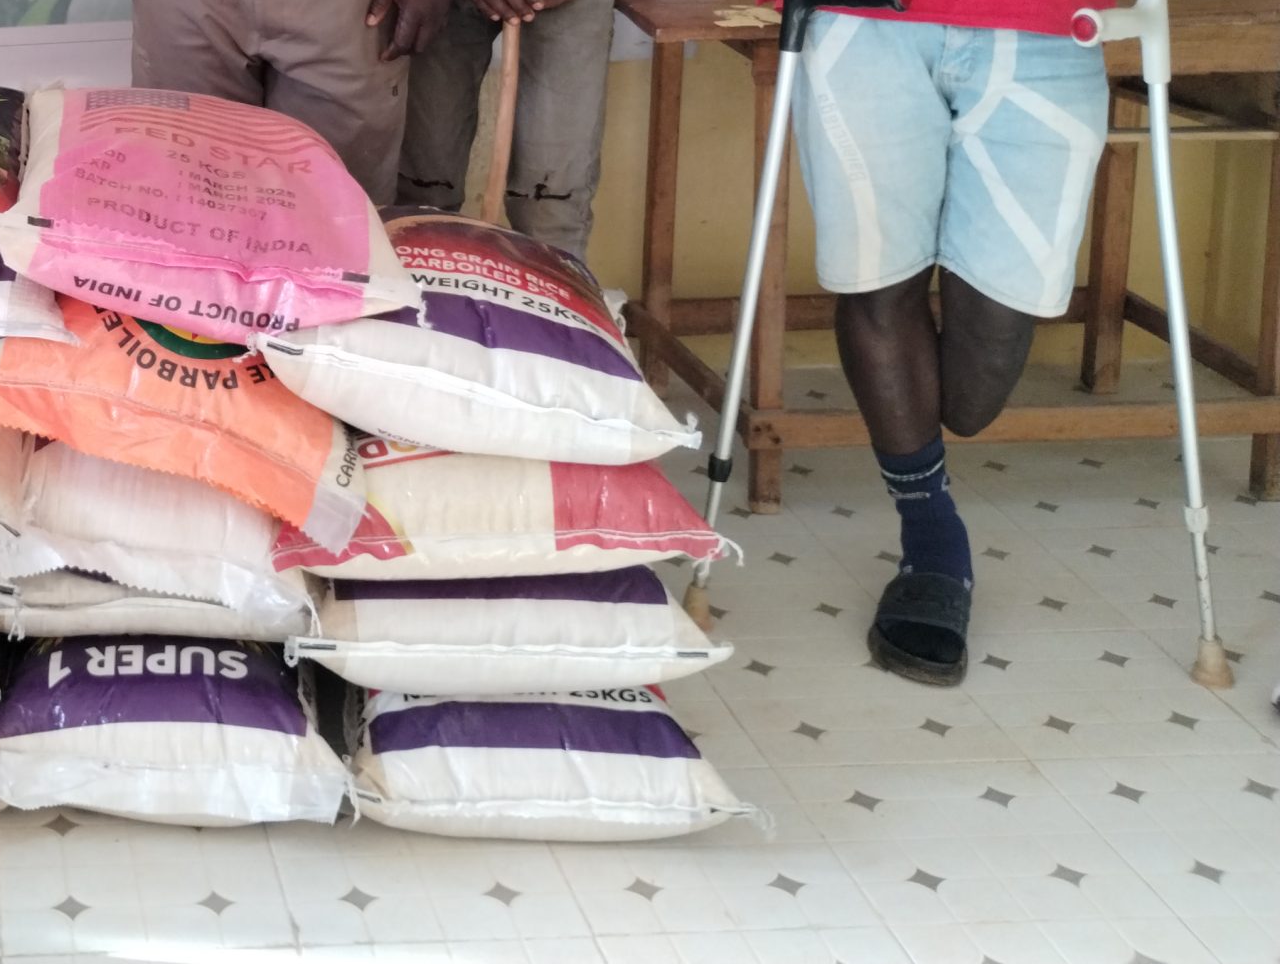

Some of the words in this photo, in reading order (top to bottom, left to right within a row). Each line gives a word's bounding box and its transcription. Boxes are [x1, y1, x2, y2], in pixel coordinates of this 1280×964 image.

[166, 149, 191, 164] 25
[199, 160, 246, 179] KGS
[209, 145, 312, 174] STAR
[75, 167, 132, 192] BATCH
[188, 171, 248, 192] MARCH
[87, 197, 200, 236] PRODUCT
[210, 227, 240, 244] OF
[245, 237, 313, 256] INDIA
[396, 246, 446, 258] ONG
[452, 252, 521, 275] GRAIN
[525, 273, 570, 300] RICE
[399, 256, 521, 285] PARBOILED
[73, 274, 142, 301] INDIA
[410, 273, 514, 300] WEIGHT
[148, 292, 182, 312] OF
[189, 300, 301, 333] PRODUCT
[48, 649, 73, 690] 1
[85, 644, 248, 680] SUPER
